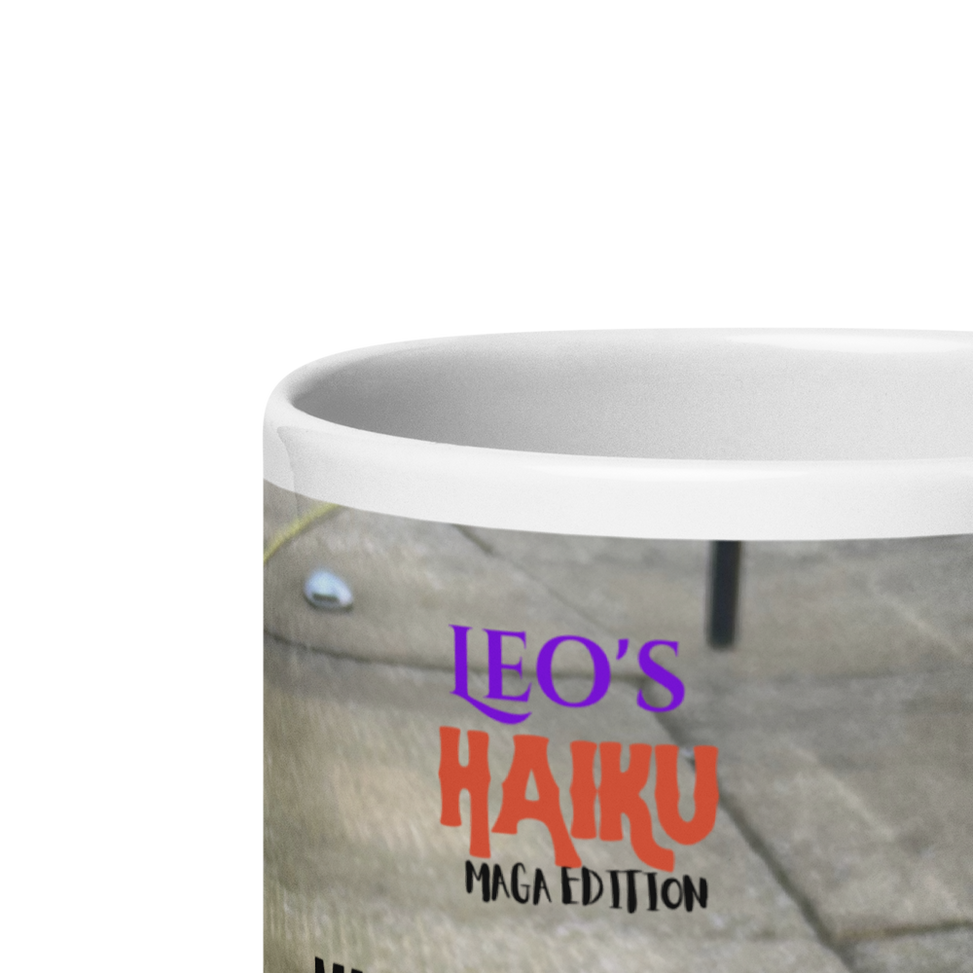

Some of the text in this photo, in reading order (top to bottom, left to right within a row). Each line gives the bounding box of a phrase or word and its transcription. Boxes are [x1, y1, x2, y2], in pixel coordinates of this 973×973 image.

[449, 624, 685, 724] LEO'S
[439, 726, 719, 871] HAIKU
[465, 861, 708, 912] MAGA EDITION
